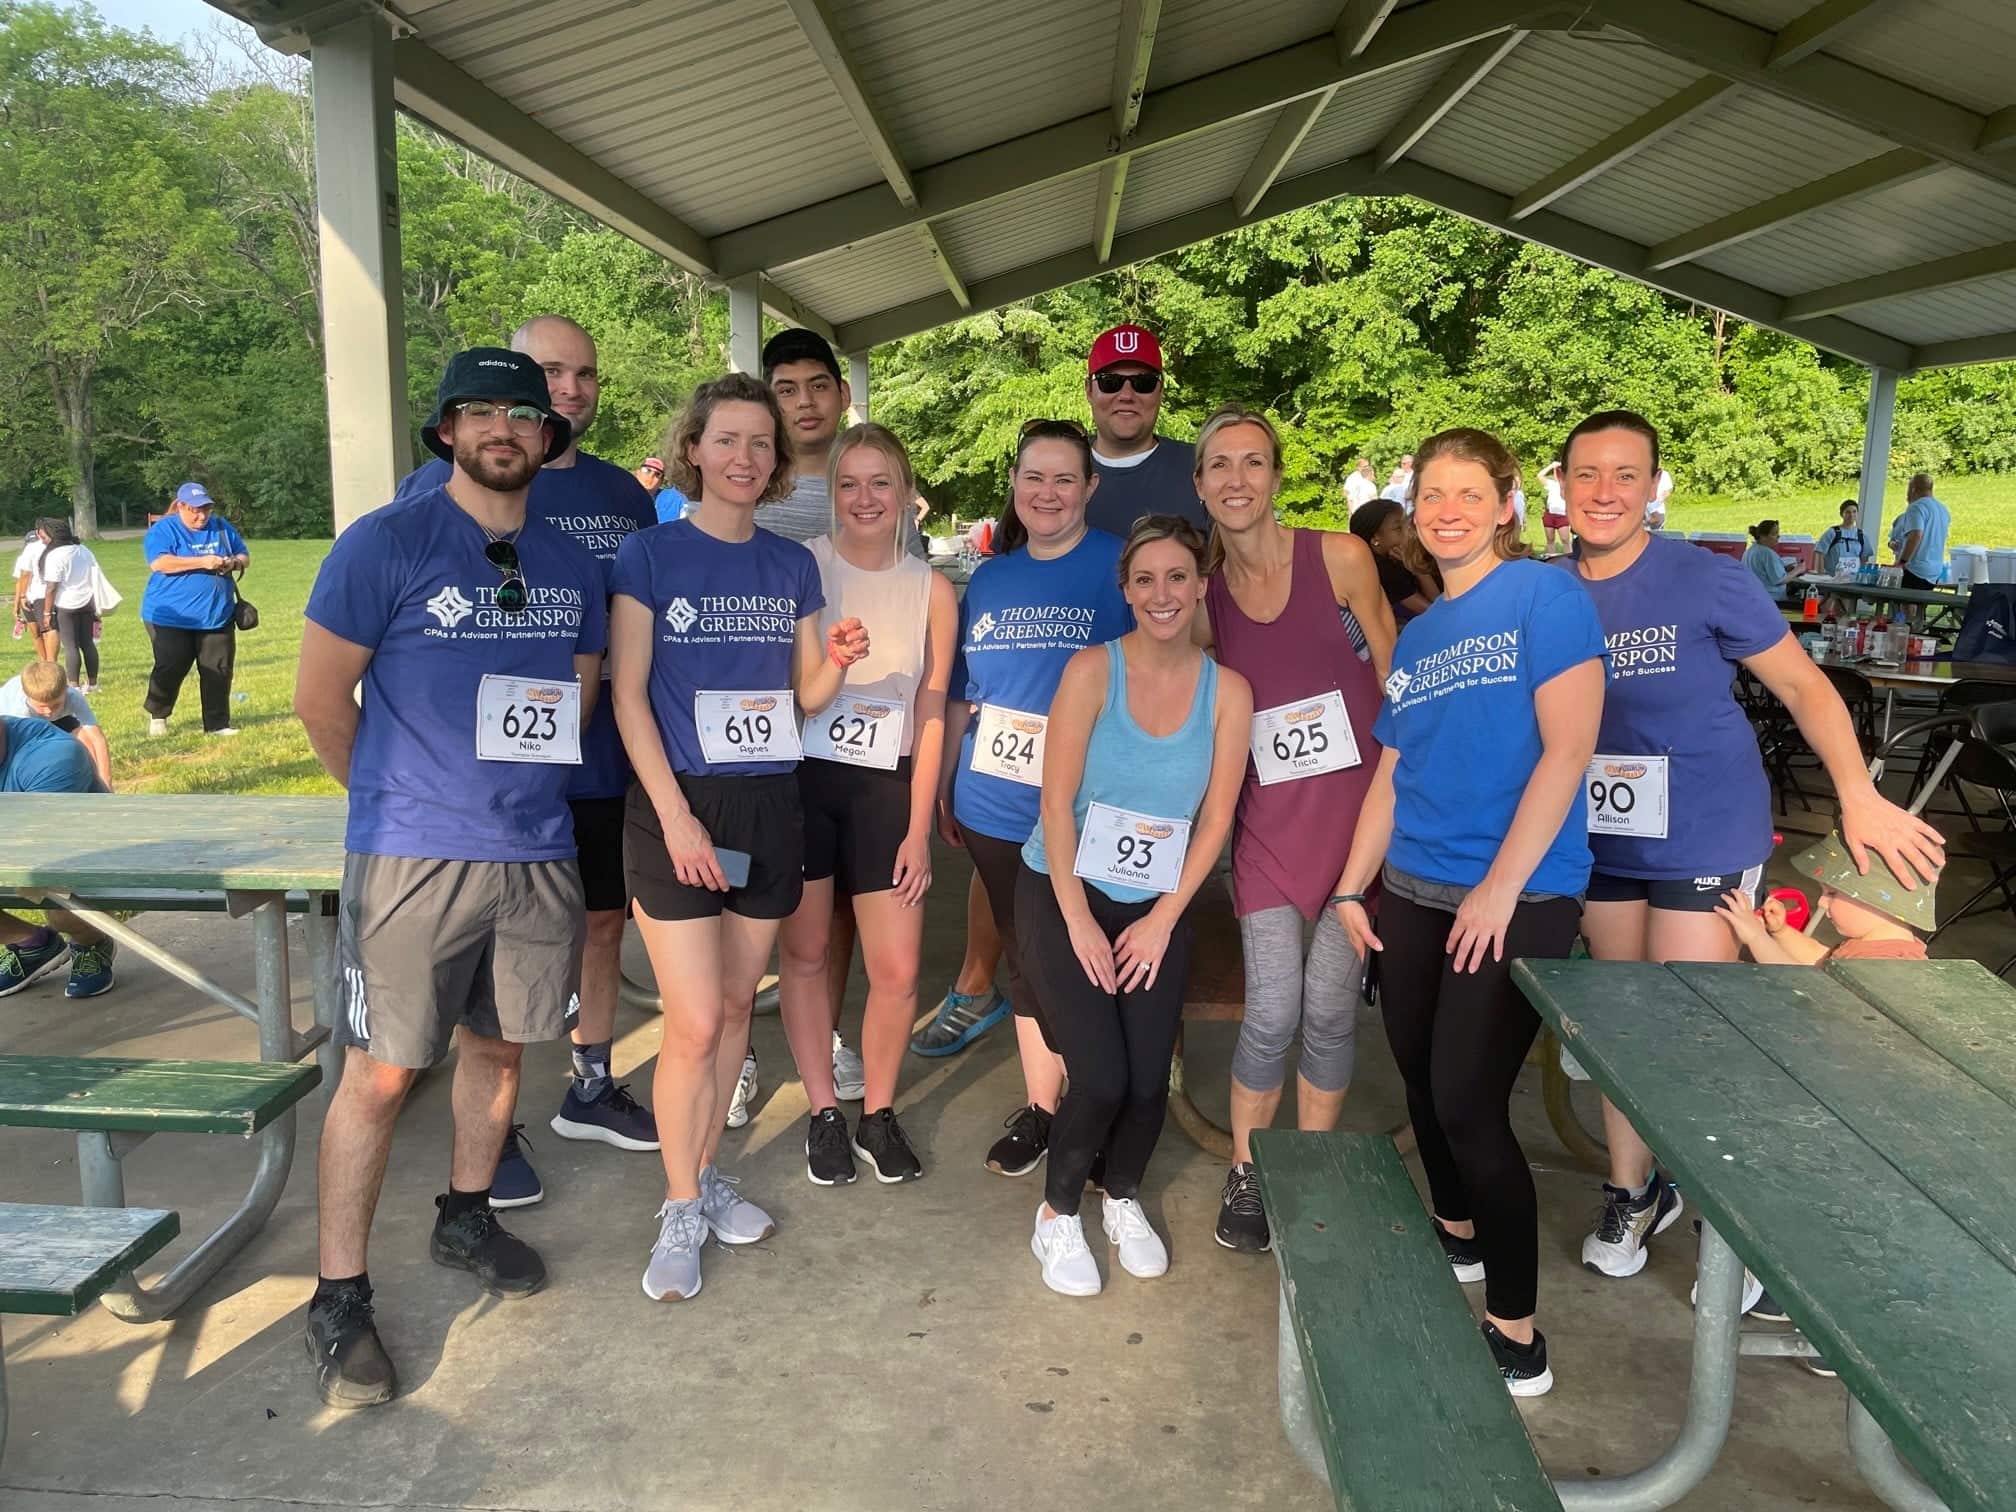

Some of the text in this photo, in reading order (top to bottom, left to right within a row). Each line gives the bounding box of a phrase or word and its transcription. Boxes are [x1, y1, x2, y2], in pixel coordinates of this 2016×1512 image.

[1113, 331, 1140, 353] U
[478, 360, 508, 368] adidas
[545, 515, 638, 532] THOMPSON
[700, 596, 797, 613] THOMPSON
[1000, 606, 1097, 622] THOMPSON
[424, 628, 448, 639] CPAs
[451, 631, 458, 639] &
[460, 630, 498, 639] Advisors
[506, 630, 546, 640] Partnering
[548, 629, 559, 638] for
[663, 635, 681, 643] CPAs
[691, 635, 721, 643] Advisors
[728, 634, 766, 643] Partnering
[767, 634, 777, 642] for
[993, 623, 1092, 640] GREENSPON
[1016, 640, 1047, 650] Partnering
[1048, 640, 1057, 648] for
[1415, 629, 1519, 675] THOMPSON
[1408, 652, 1519, 694] GREENSPON
[1622, 669, 1636, 677] for
[1637, 666, 1676, 676] Success
[1467, 677, 1479, 687] for
[1480, 675, 1517, 686] Success
[503, 703, 557, 741] 623
[725, 714, 772, 745] 619
[829, 714, 878, 748] 621
[520, 741, 542, 751] Niko
[739, 744, 769, 755] Agnes
[834, 743, 866, 756] Megan
[992, 730, 1034, 765] 624
[1273, 722, 1329, 761] 625
[1000, 760, 1020, 774] Tracy
[1292, 758, 1319, 769] Tricia
[1590, 780, 1635, 813] 90
[1597, 813, 1630, 825] Allison
[1117, 835, 1155, 869] 93
[1107, 863, 1150, 880] Julianna
